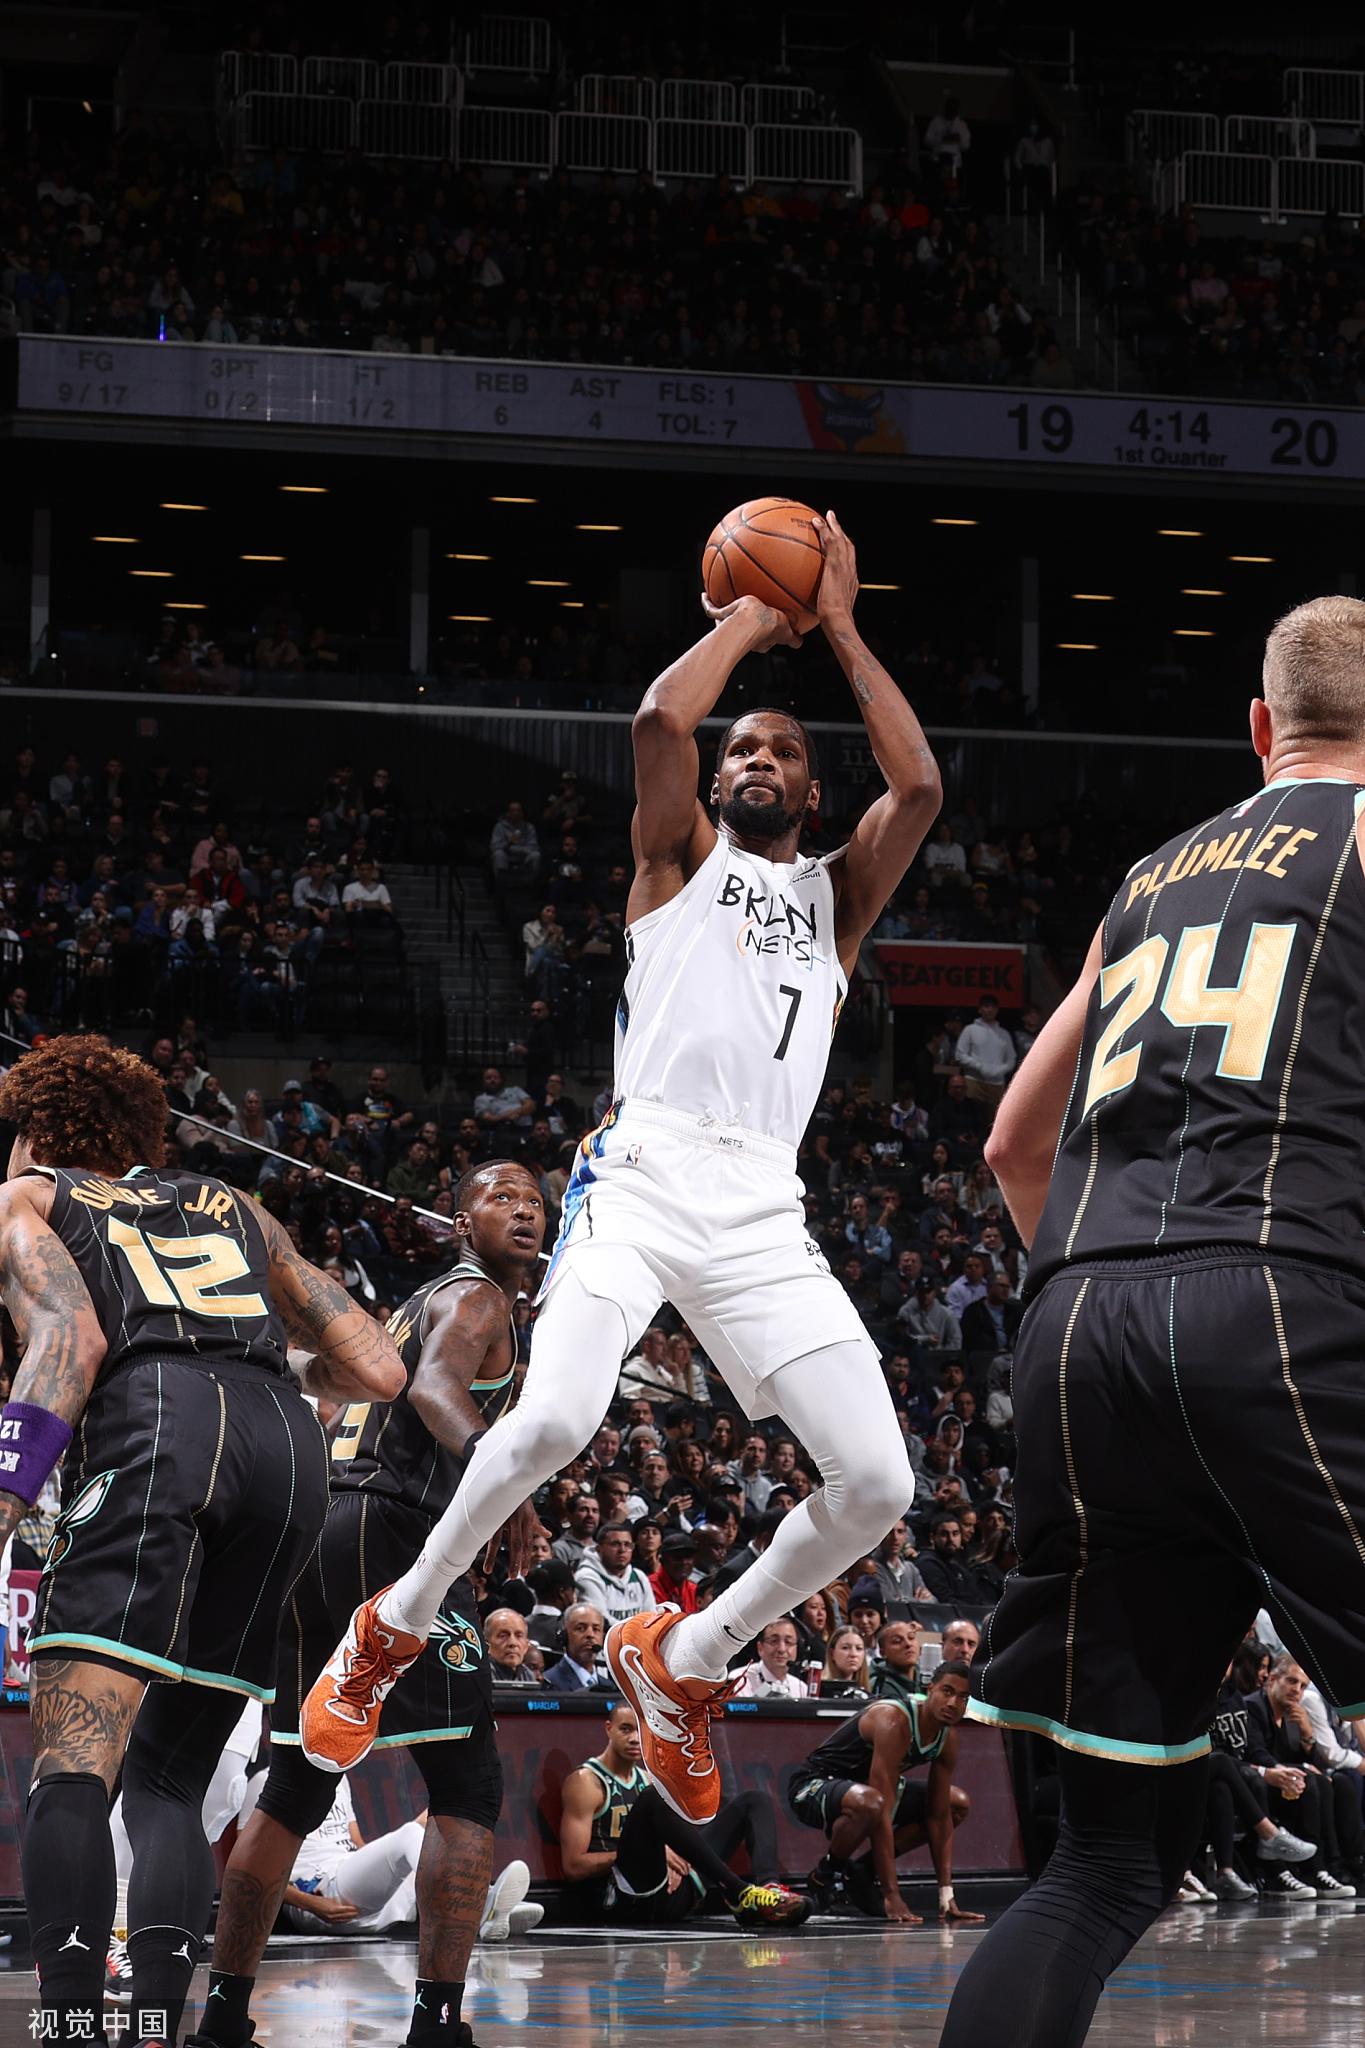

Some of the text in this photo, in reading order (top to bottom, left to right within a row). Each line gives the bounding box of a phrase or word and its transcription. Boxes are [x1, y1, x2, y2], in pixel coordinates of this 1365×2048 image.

[77, 350, 114, 372] FG
[210, 356, 259, 380] 3PT
[354, 365, 386, 387] FT
[475, 371, 529, 395] REB
[569, 377, 621, 400] AST
[658, 381, 735, 406] FLS: 1
[494, 405, 508, 426] 6
[588, 411, 602, 431] 4
[658, 412, 737, 439] TOL: 7
[1007, 402, 1074, 454] 19
[1128, 407, 1212, 445] 4:14
[1270, 417, 1338, 468] 20
[1114, 445, 1228, 470] 1st Quarter
[792, 871, 821, 883] webull
[1123, 824, 1319, 912] PLUMLEE
[745, 928, 810, 961] NETS
[884, 961, 1015, 991] SEATGEEK
[773, 983, 802, 1061] 7
[1081, 922, 1298, 1123] 24
[718, 1135, 744, 1149] NETS
[183, 1184, 234, 1229] JR.
[107, 1214, 269, 1318] 12
